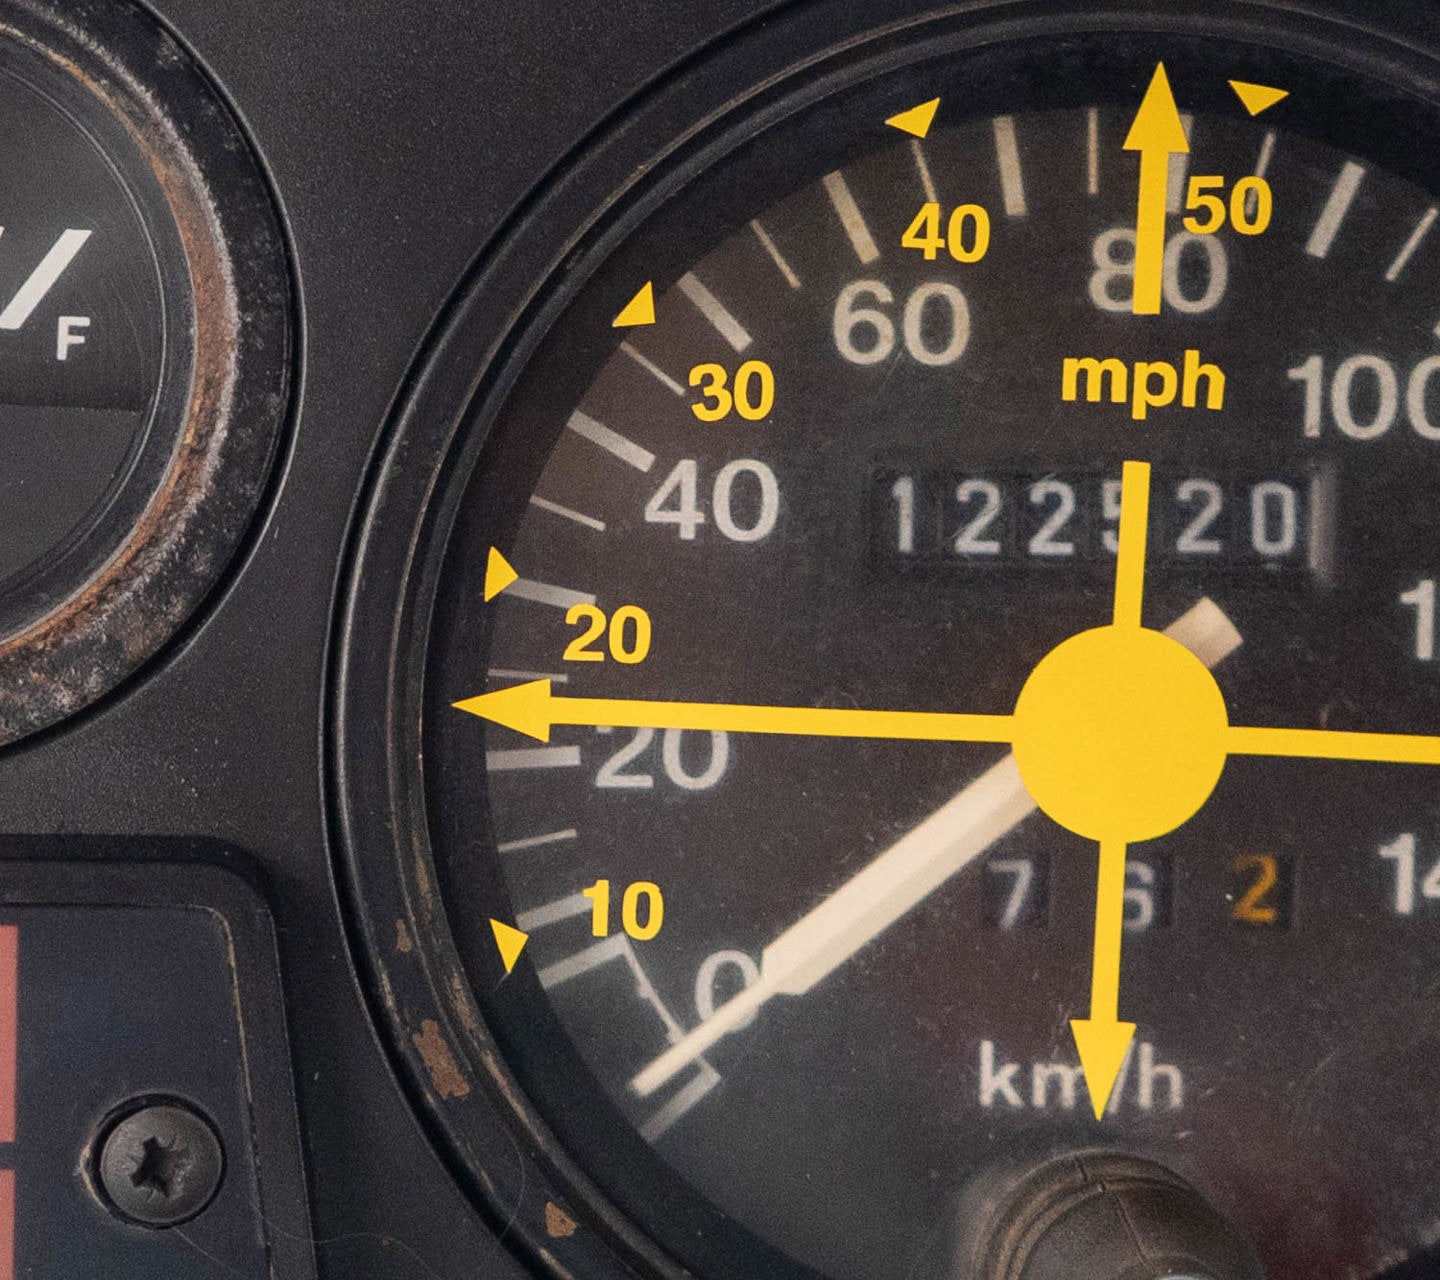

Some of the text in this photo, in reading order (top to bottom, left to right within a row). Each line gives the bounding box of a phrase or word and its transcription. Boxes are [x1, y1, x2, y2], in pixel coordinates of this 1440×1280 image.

[901, 202, 991, 263] 40
[1182, 176, 1273, 235] 50
[1088, 228, 1229, 314] 80
[56, 316, 91, 361] F
[833, 279, 971, 366] 60
[688, 360, 775, 422] 30
[1061, 350, 1226, 420] mph
[644, 458, 781, 543] 40
[562, 603, 652, 664] 20
[594, 723, 731, 792] 20
[583, 879, 664, 941] 10
[978, 1039, 1184, 1115] km/h
